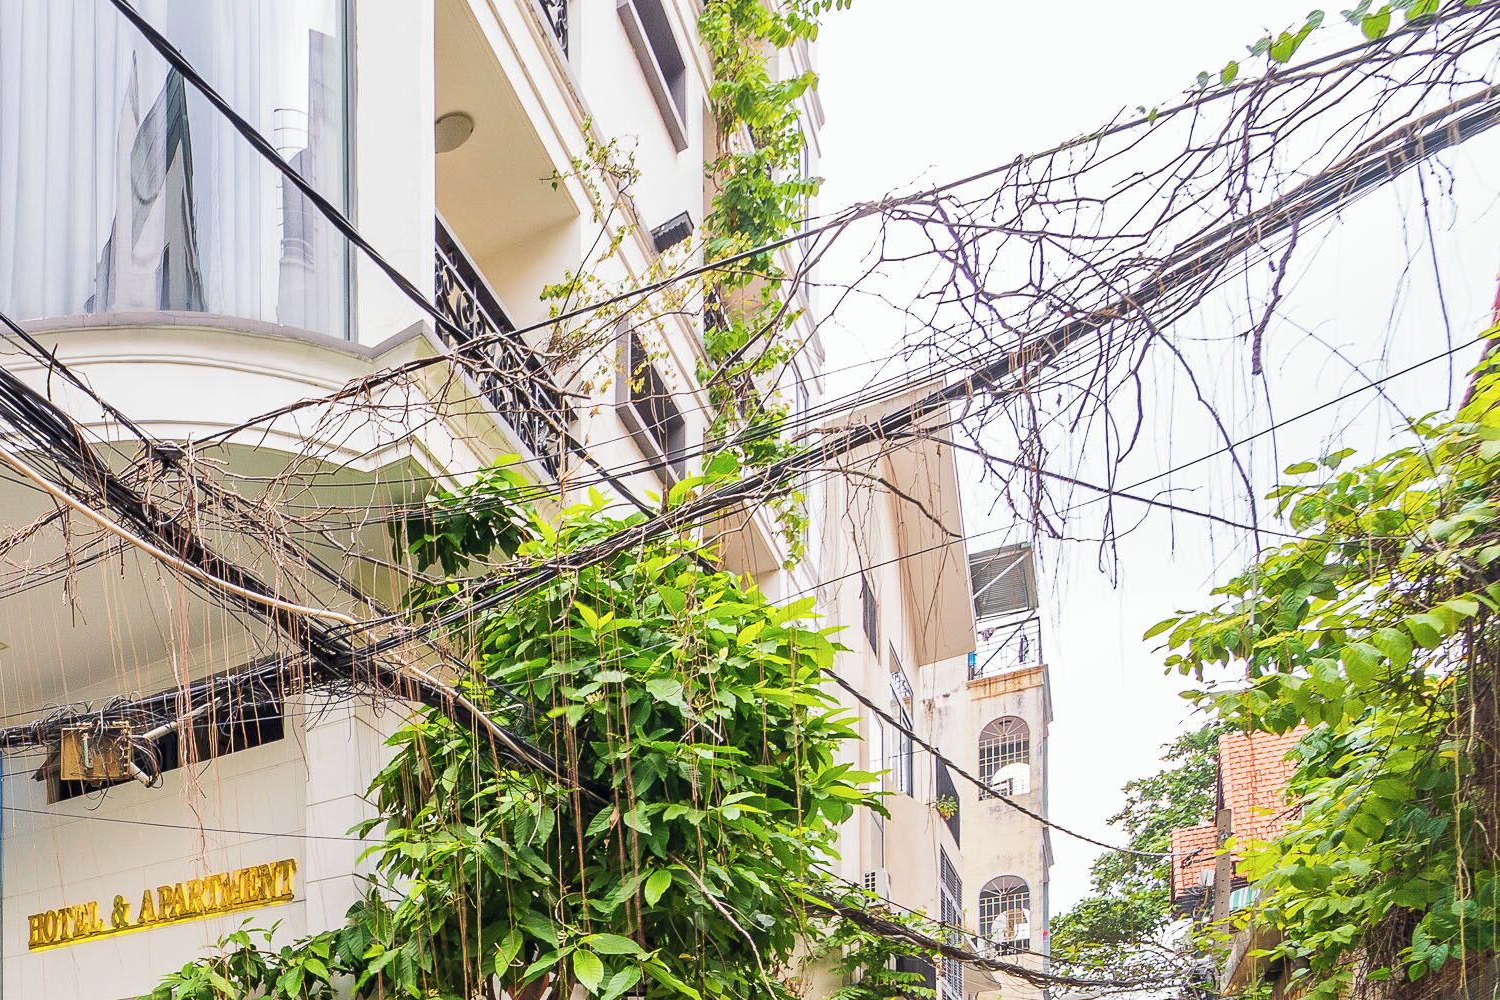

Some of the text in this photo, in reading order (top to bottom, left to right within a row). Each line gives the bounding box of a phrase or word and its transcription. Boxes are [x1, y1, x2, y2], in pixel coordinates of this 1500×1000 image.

[28, 858, 297, 947] HOTEL & APARTMENT
